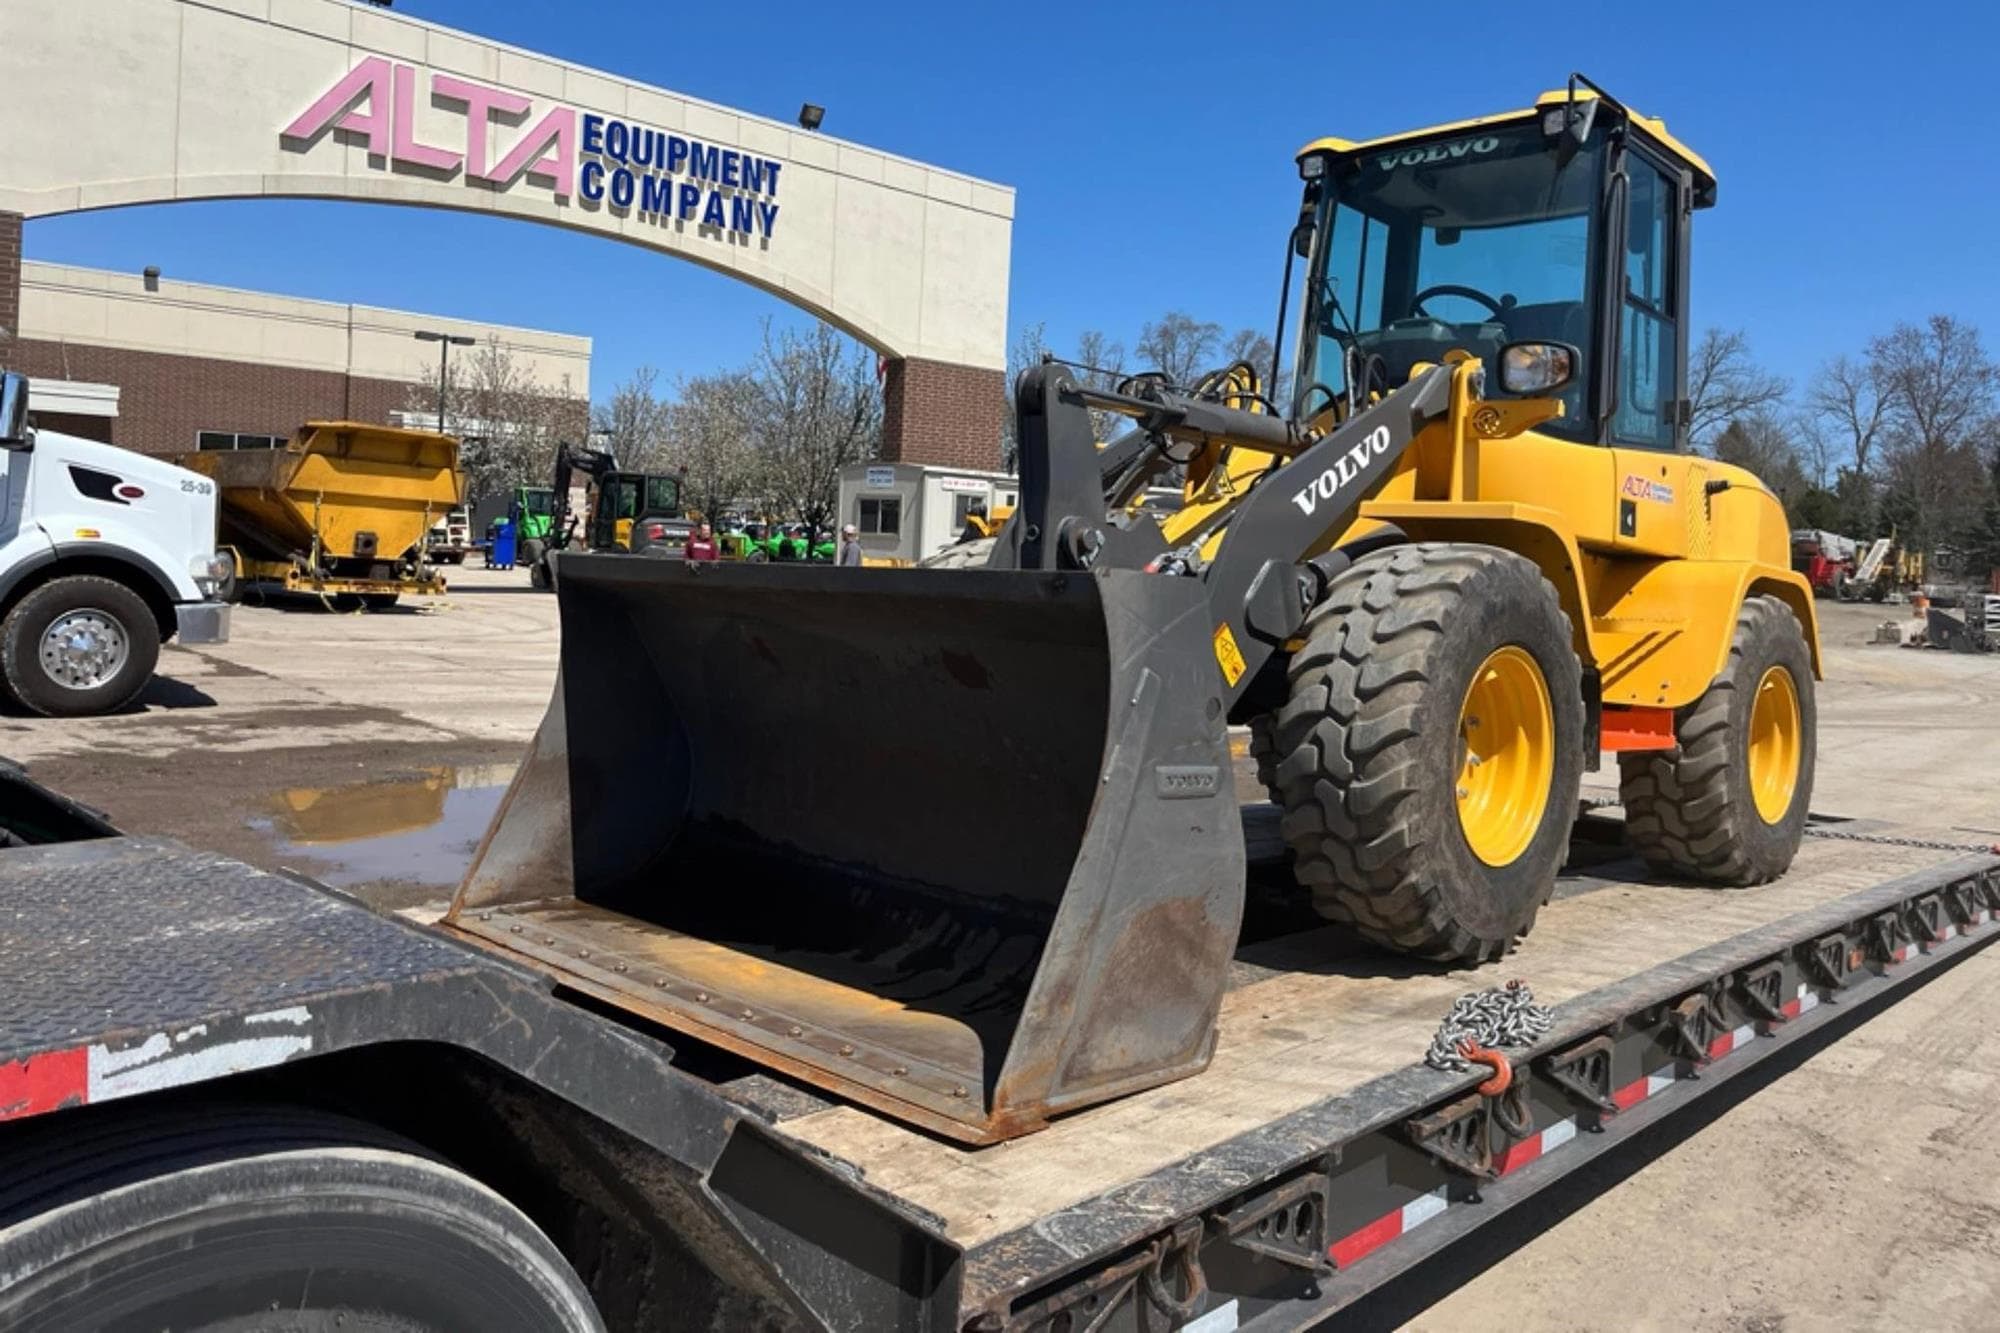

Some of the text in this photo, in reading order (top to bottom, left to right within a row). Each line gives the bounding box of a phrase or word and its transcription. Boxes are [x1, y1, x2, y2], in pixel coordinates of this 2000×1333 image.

[280, 55, 576, 197] ALTA
[580, 113, 783, 197] EQUIPMENT
[1379, 138, 1499, 171] VOLVO
[580, 160, 780, 238] COMPANY
[1291, 425, 1391, 516] VOLVO
